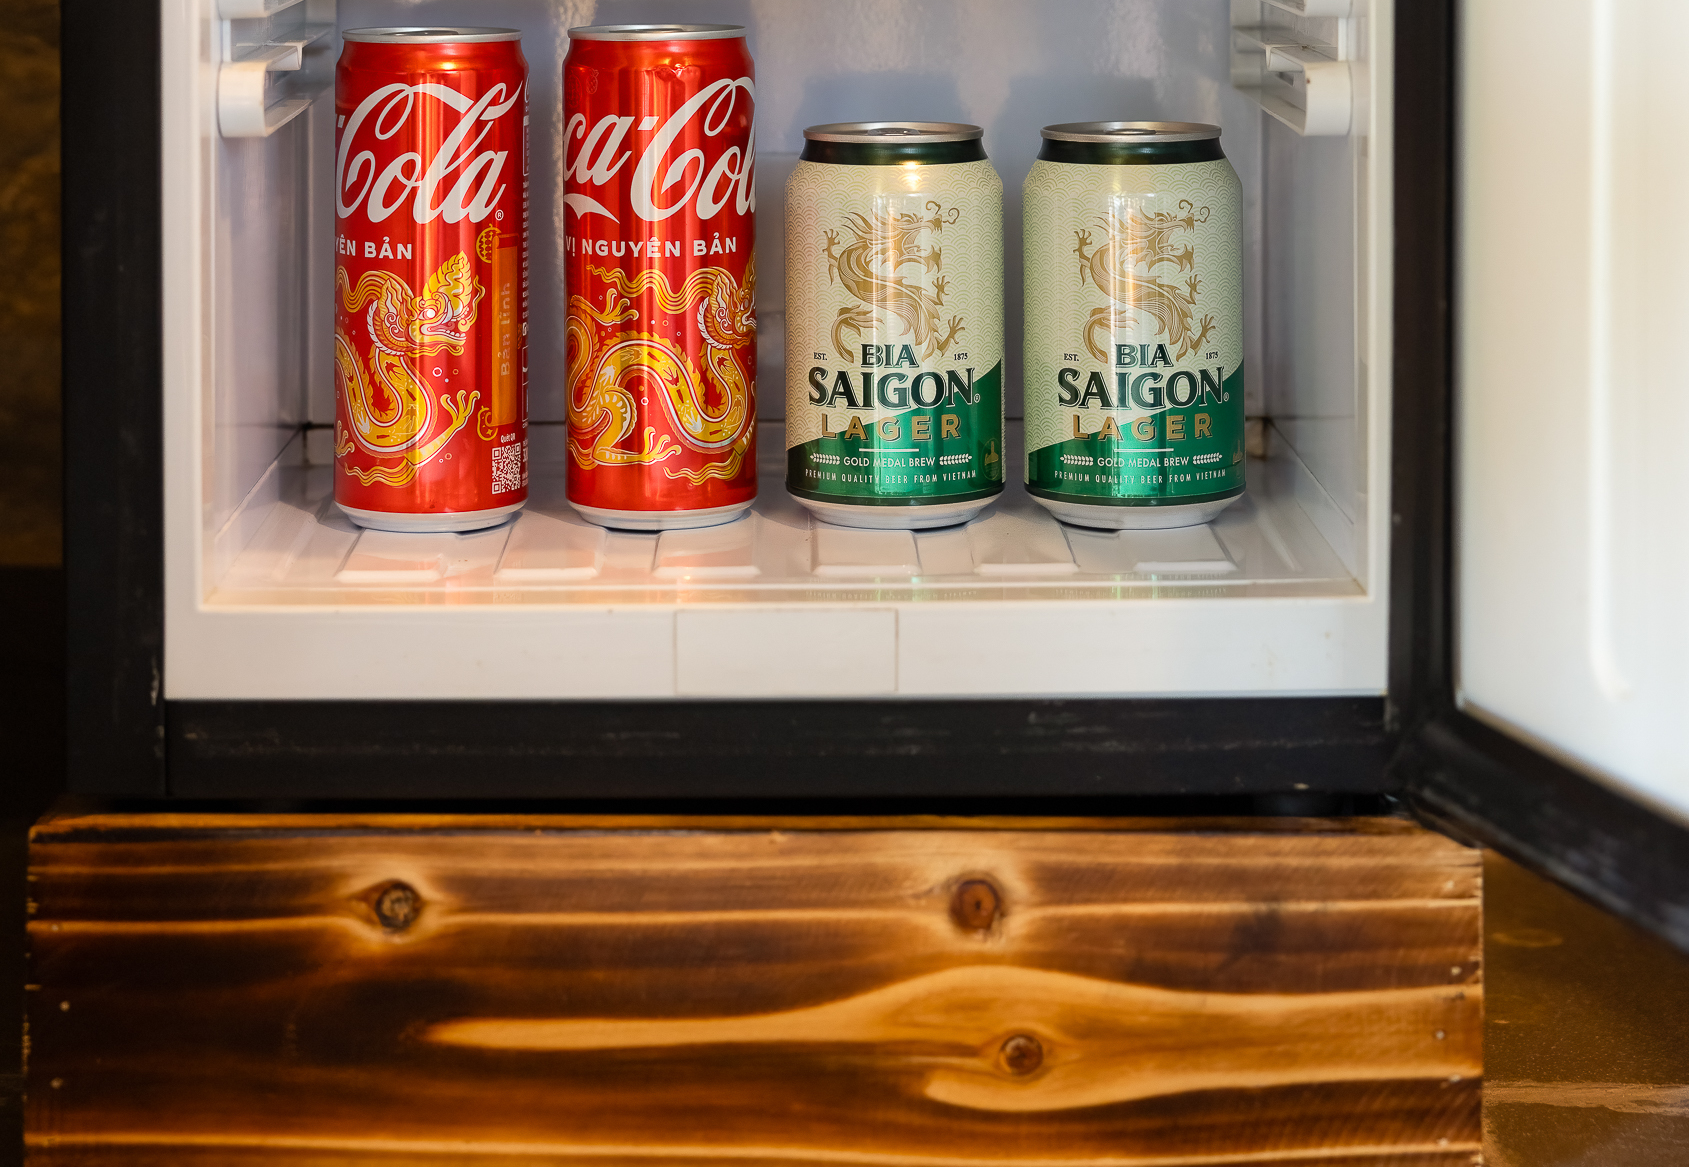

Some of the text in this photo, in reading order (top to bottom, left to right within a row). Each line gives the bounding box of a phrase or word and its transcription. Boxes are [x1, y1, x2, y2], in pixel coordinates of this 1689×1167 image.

[365, 236, 412, 259] BẢN
[582, 236, 681, 257] NGUYÊN
[693, 232, 737, 256] BẢN
[814, 352, 827, 360] EST.
[861, 343, 919, 368] BIA
[1064, 353, 1079, 362] EST.
[1115, 343, 1174, 368] BIA
[1206, 352, 1218, 360] 1875
[809, 366, 975, 410] SAIGON
[1058, 366, 1224, 410] SAIGON
[822, 413, 960, 442] LAGER
[1073, 413, 1212, 442] LAGER
[843, 457, 935, 468] GOLD MEDAL BREW
[1097, 456, 1190, 468] GOLD MEDAL BREW
[805, 468, 976, 484] PREMIUM QUALITY BEER FROM VIETNAM
[1054, 469, 1226, 484] PREMIUM QUALITY BEER FROM VIETNAM
